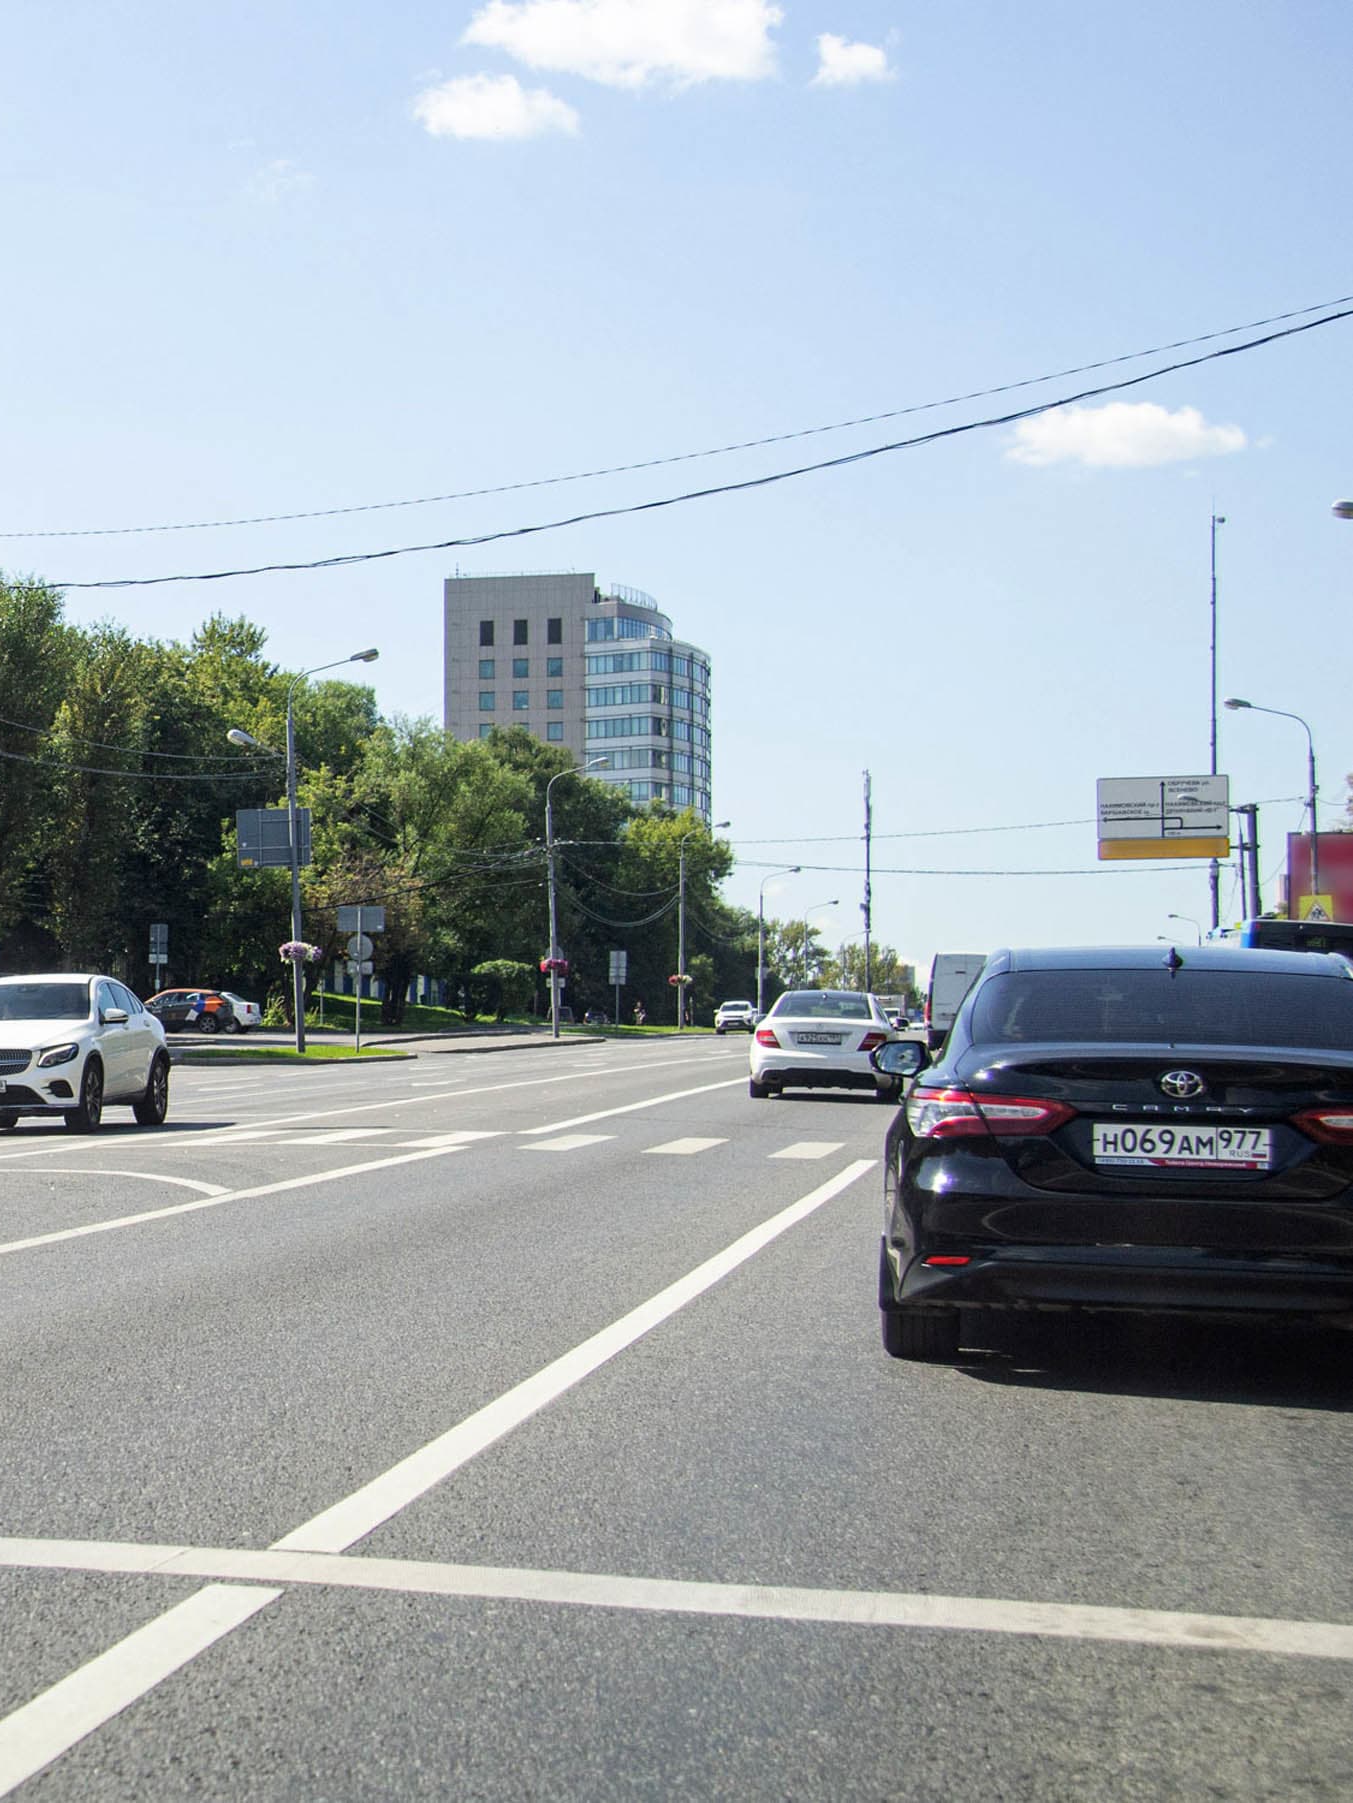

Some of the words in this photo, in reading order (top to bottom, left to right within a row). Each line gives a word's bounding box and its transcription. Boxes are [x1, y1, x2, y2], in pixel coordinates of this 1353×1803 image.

[1101, 1128, 1215, 1156] Н069АМ
[1219, 1130, 1262, 1150] 977
[1229, 1149, 1250, 1159] RUS
